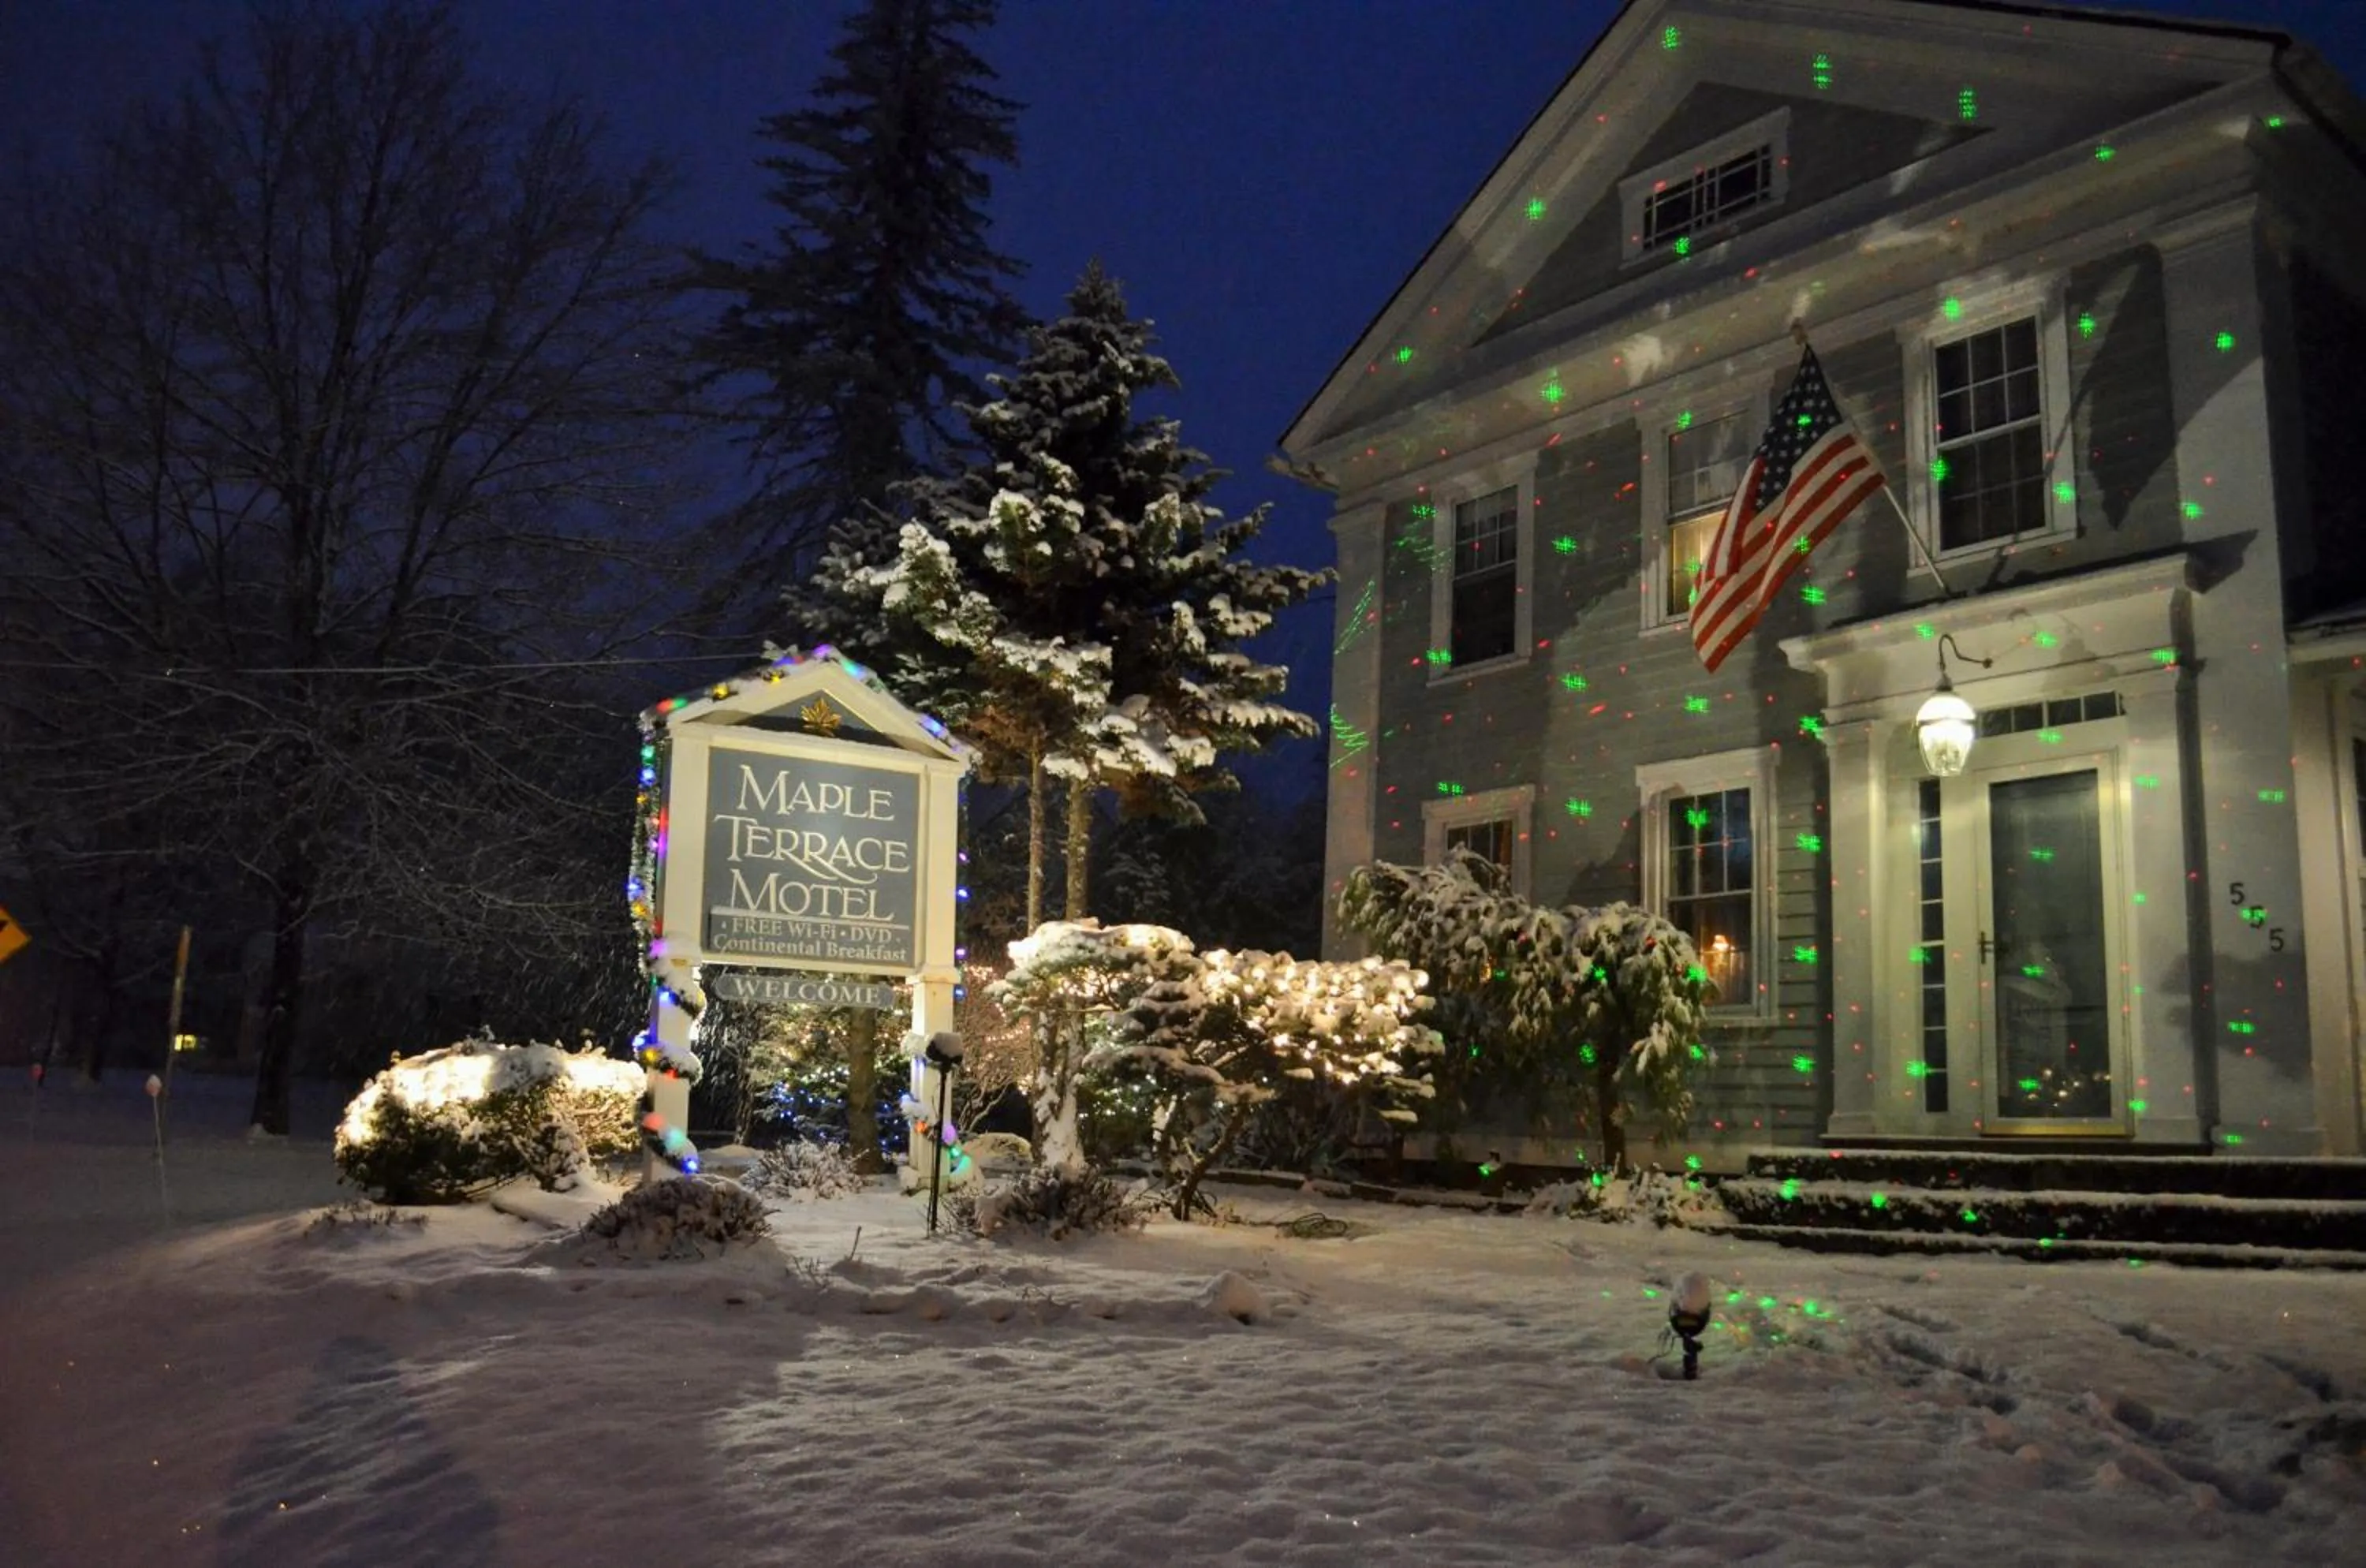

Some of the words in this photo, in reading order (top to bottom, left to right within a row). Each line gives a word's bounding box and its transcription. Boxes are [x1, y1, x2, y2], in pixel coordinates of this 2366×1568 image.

[737, 765, 894, 821] MAPLE
[714, 815, 909, 883] TERRACE
[730, 868, 894, 920] MOTEL
[714, 935, 821, 957] Continental
[828, 941, 906, 961] Breakfast
[732, 917, 783, 935] FREE
[787, 920, 837, 940] Wi-Fi
[850, 927, 892, 943] DVD
[735, 978, 880, 1004] WELCOME
